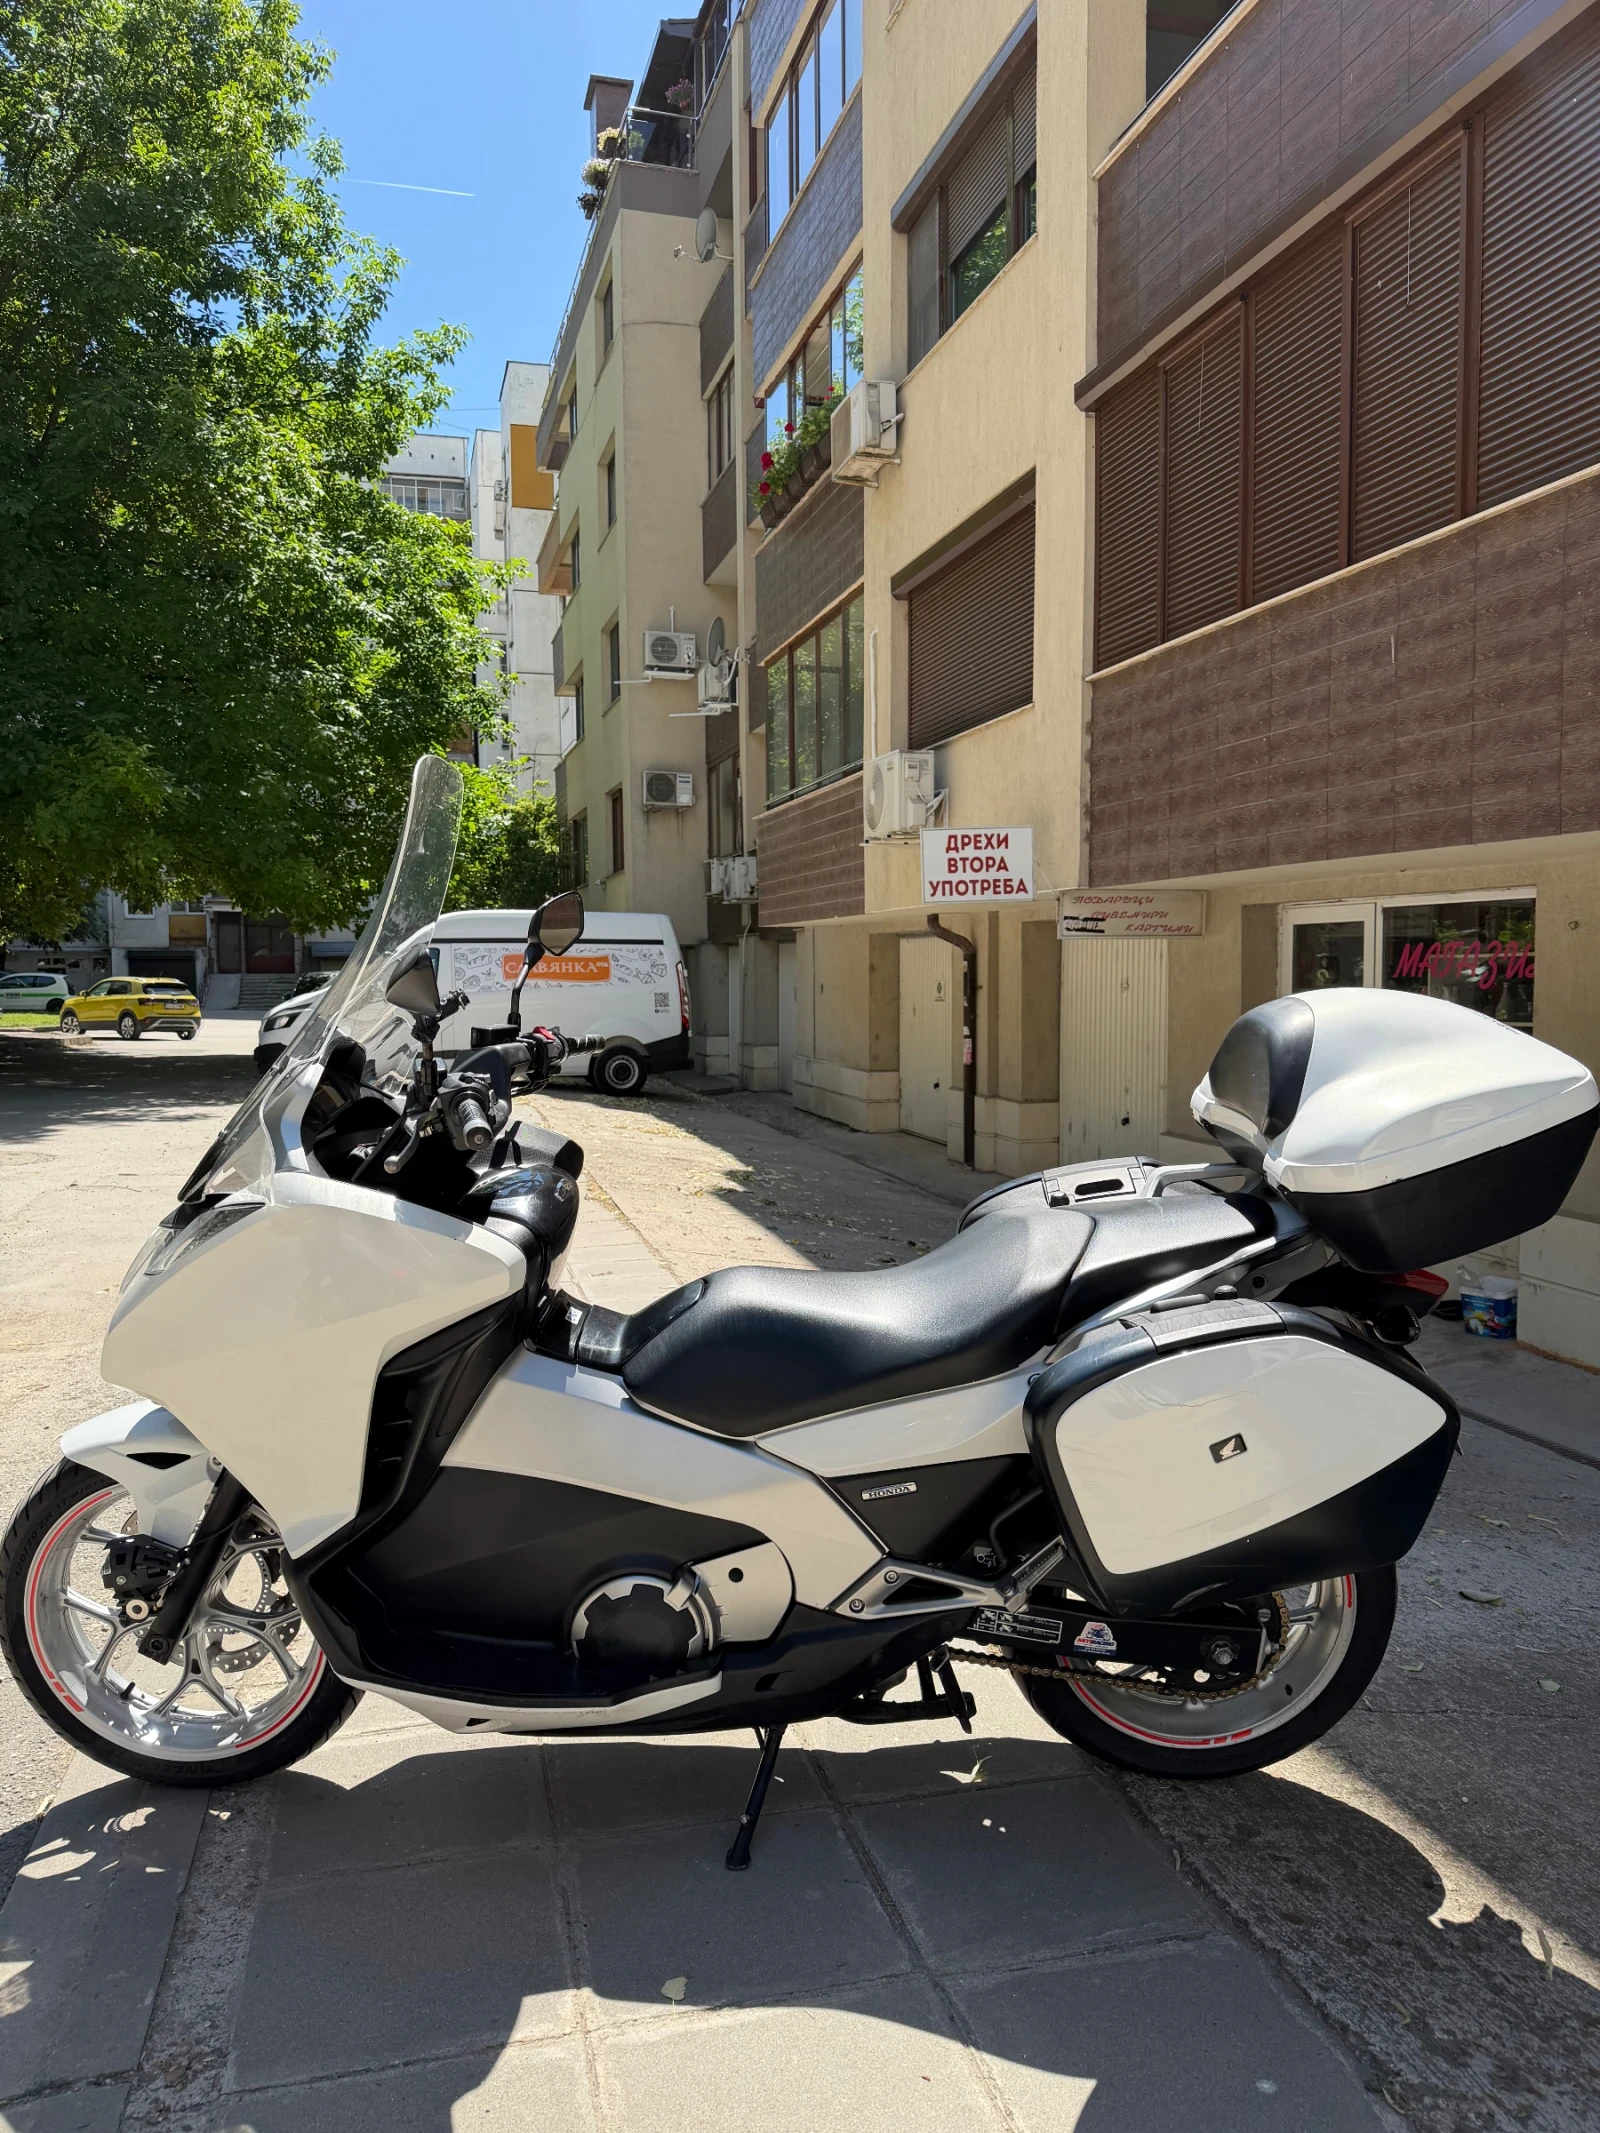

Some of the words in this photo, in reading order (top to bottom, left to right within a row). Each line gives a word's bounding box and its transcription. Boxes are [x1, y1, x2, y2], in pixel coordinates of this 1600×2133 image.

[945, 832, 1009, 854] ДРЕХИ
[947, 856, 1009, 874] ВТОРА
[929, 878, 1028, 897] УПОТРЕБА
[1124, 923, 1195, 934] КАРТИНИ
[867, 1486, 912, 1499] HONDA
